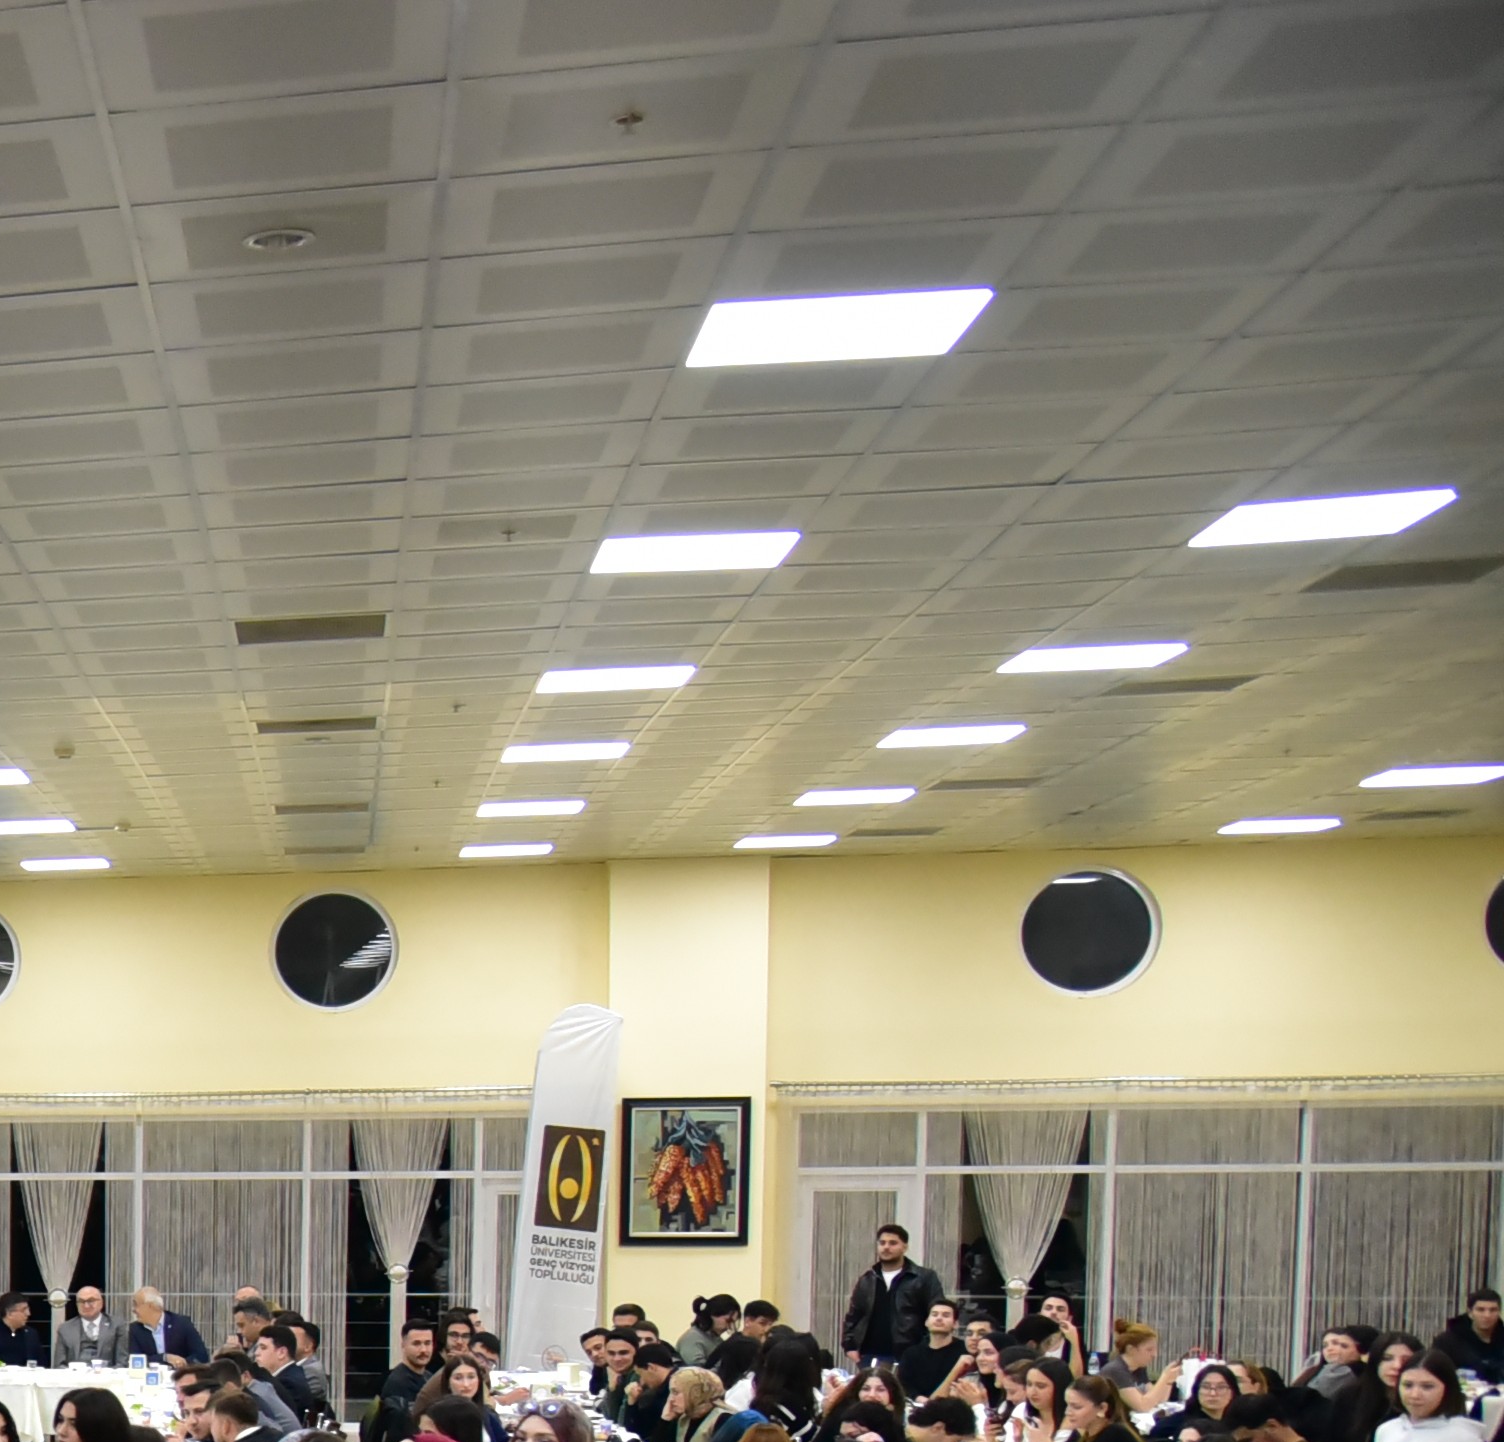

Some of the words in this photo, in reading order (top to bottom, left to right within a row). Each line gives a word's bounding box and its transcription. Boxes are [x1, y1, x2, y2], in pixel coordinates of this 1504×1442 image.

[532, 1234, 596, 1251] BALIKESİR
[530, 1245, 596, 1262] ÜNİVERSİTESİ
[529, 1257, 557, 1270] GENÇ
[559, 1260, 595, 1272] VİZYON
[529, 1268, 595, 1285] TOPLULUĞU
